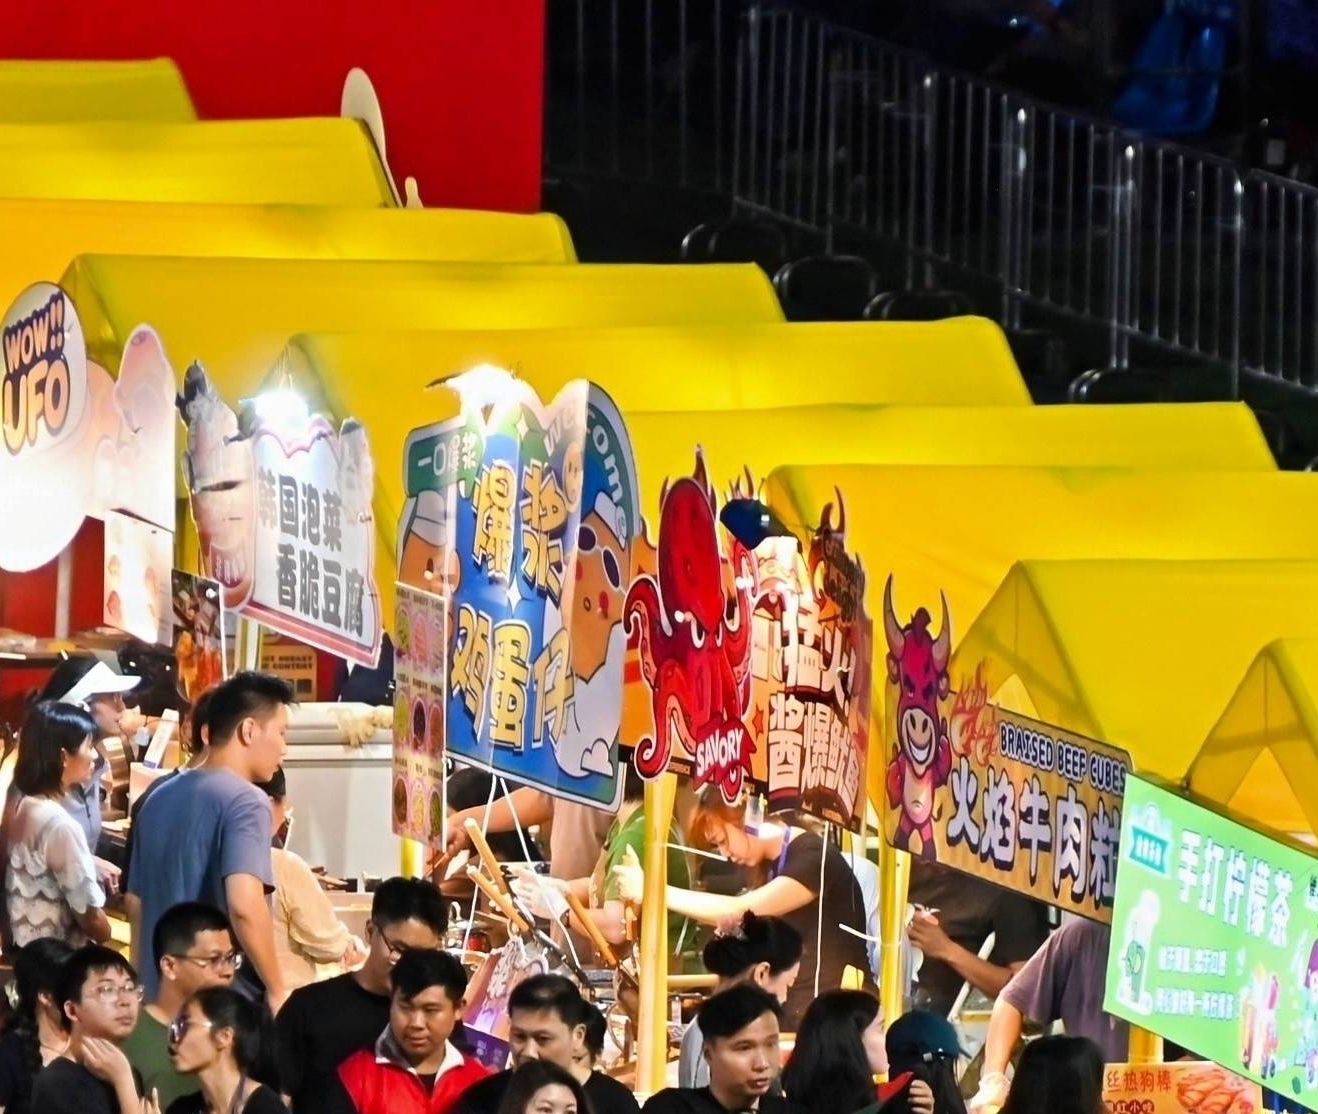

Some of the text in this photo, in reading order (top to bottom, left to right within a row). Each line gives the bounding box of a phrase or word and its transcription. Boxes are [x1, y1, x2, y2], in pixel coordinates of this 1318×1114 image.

[2, 291, 65, 374] WOW!!
[2, 354, 71, 455] UFO
[258, 466, 342, 551] 韩国泡菜
[473, 459, 569, 602] 爆浆
[278, 543, 365, 637] 香脆豆腐
[450, 604, 575, 752] 鸡蛋仔
[696, 728, 744, 777] SAVORY
[1000, 722, 1054, 771] BRAISED
[1057, 740, 1086, 782] BEEF
[1178, 829, 1294, 948] 手打柠檬茶
